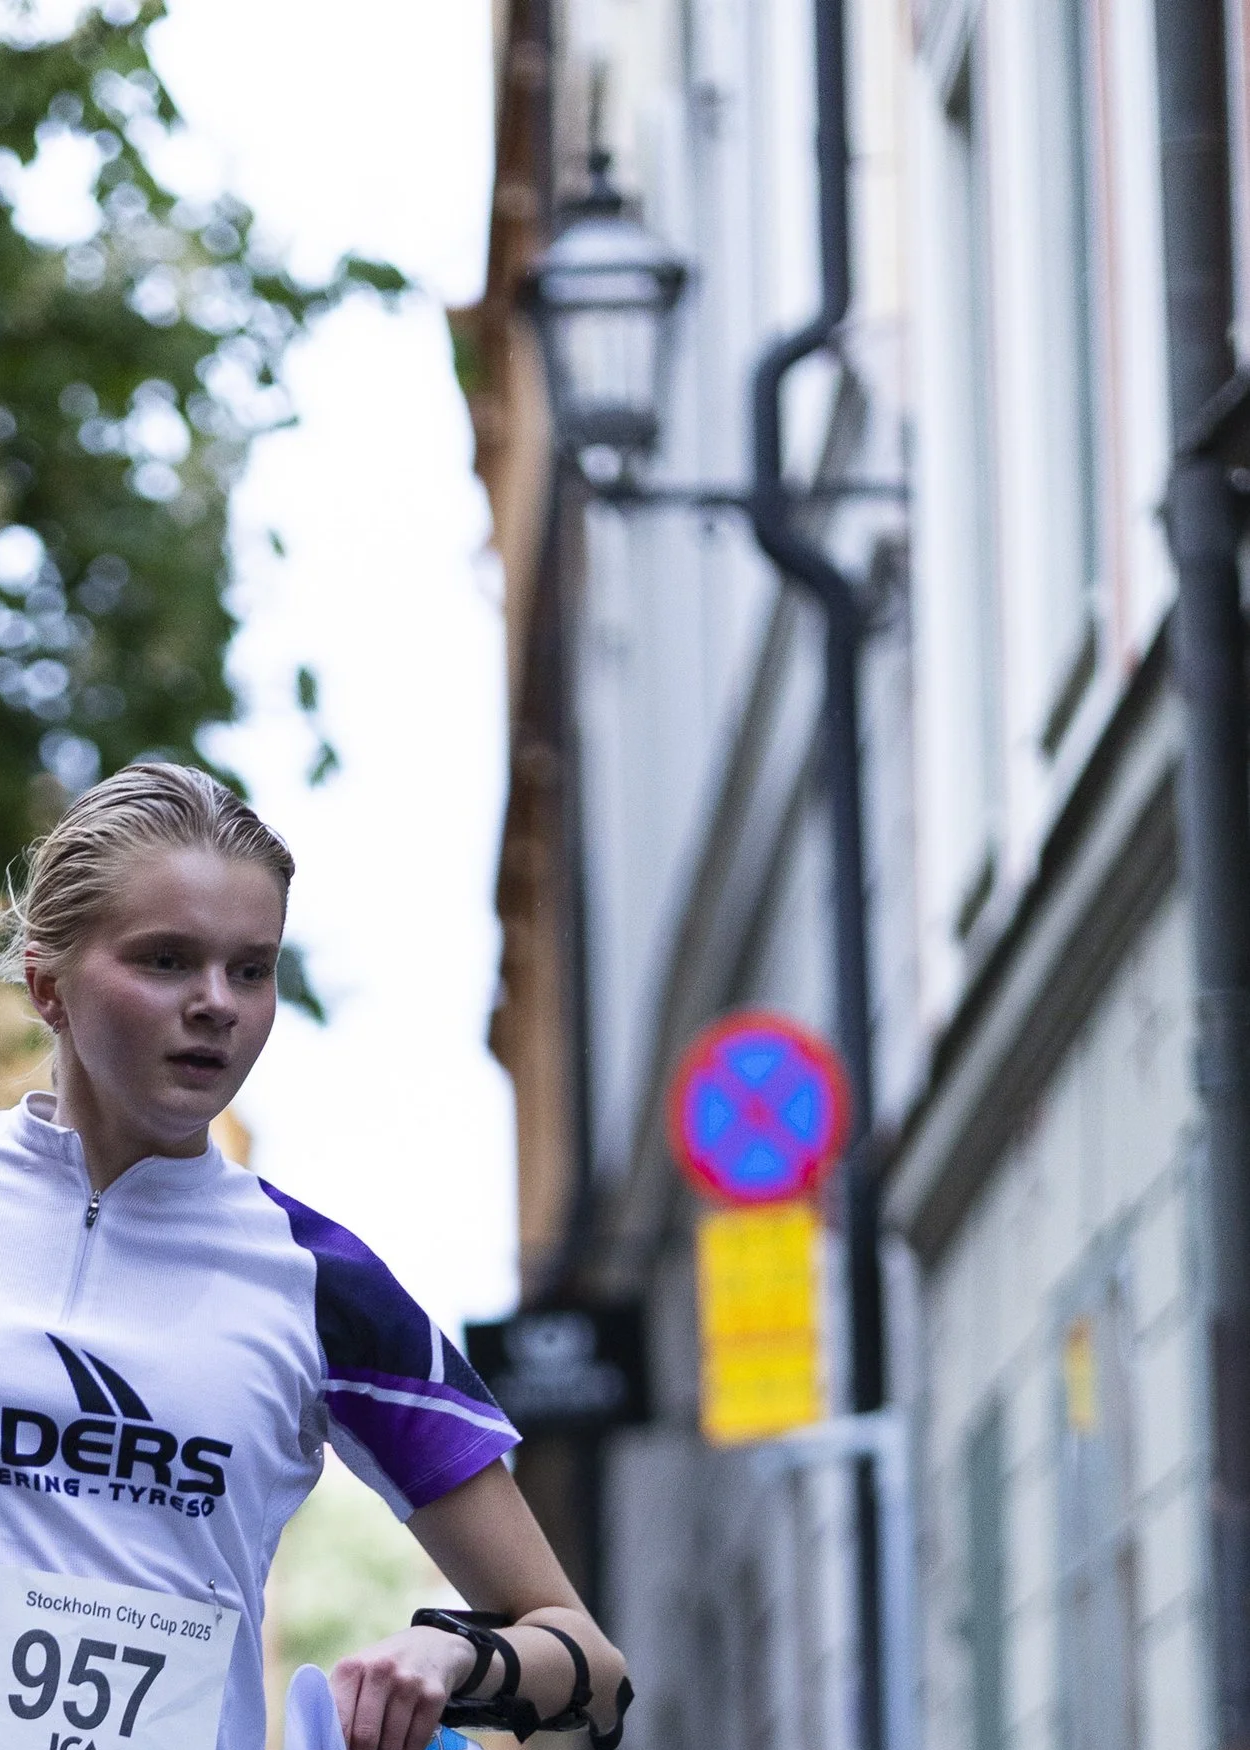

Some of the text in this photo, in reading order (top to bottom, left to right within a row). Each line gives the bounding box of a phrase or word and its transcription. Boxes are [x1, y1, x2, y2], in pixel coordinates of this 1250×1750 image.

[26, 1590, 212, 1641] Stockholm City Cup 2025
[8, 1629, 166, 1738] 957
